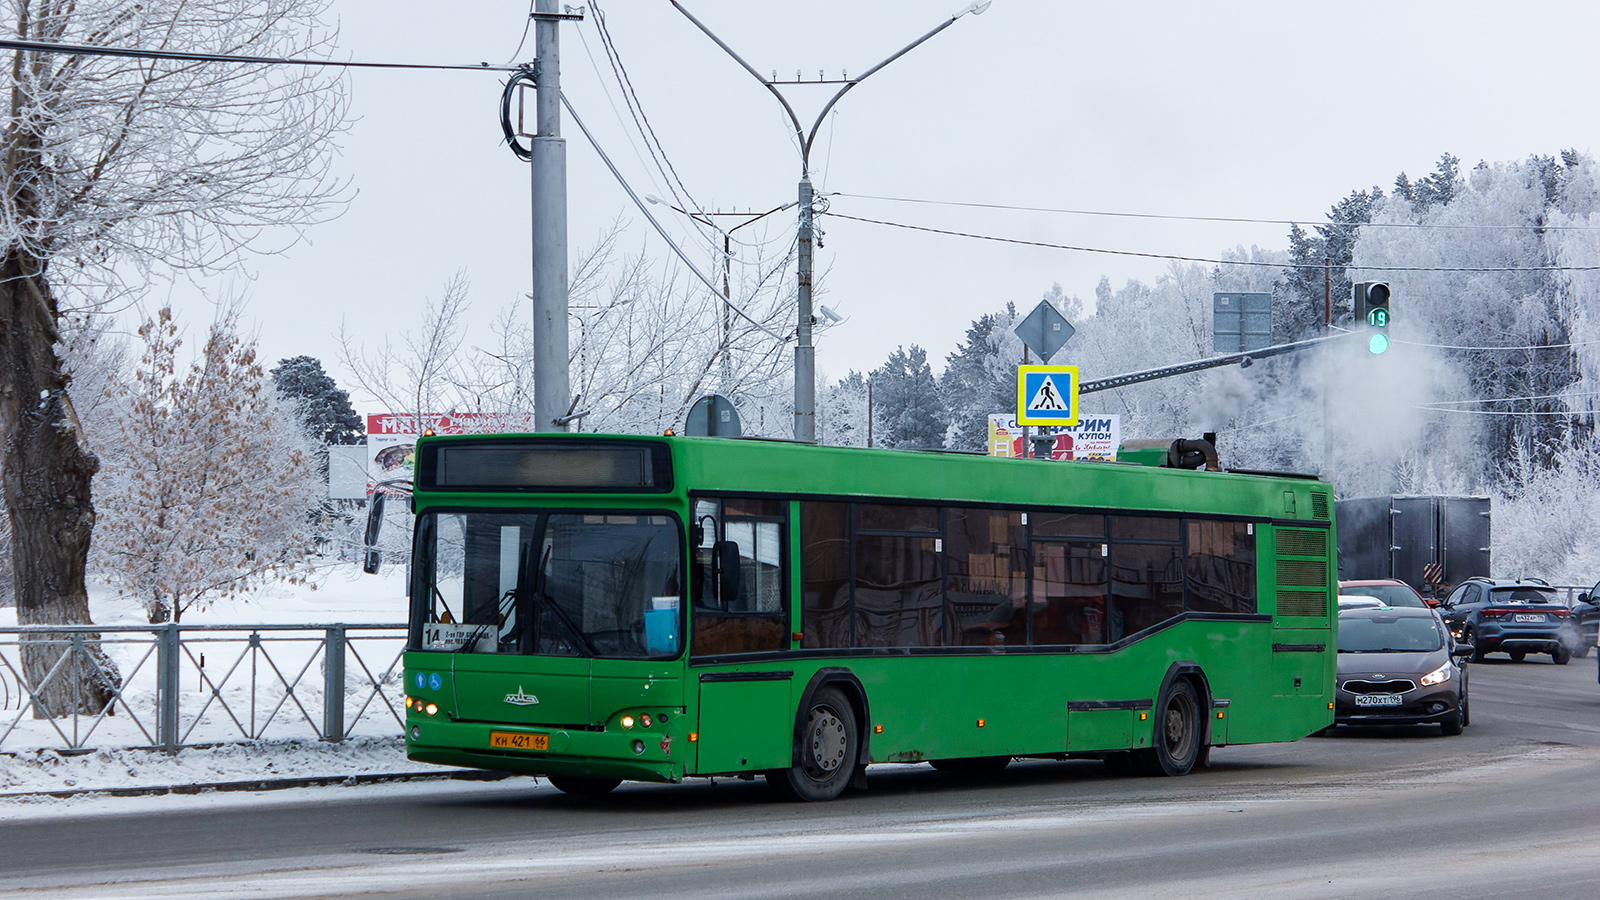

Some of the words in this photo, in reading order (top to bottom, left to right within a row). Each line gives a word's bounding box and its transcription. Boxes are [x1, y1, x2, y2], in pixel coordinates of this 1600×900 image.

[1371, 311, 1386, 327] 19
[425, 628, 440, 645] 14
[495, 737, 507, 746] КН
[512, 736, 529, 747] 421
[535, 736, 545, 745] 66
